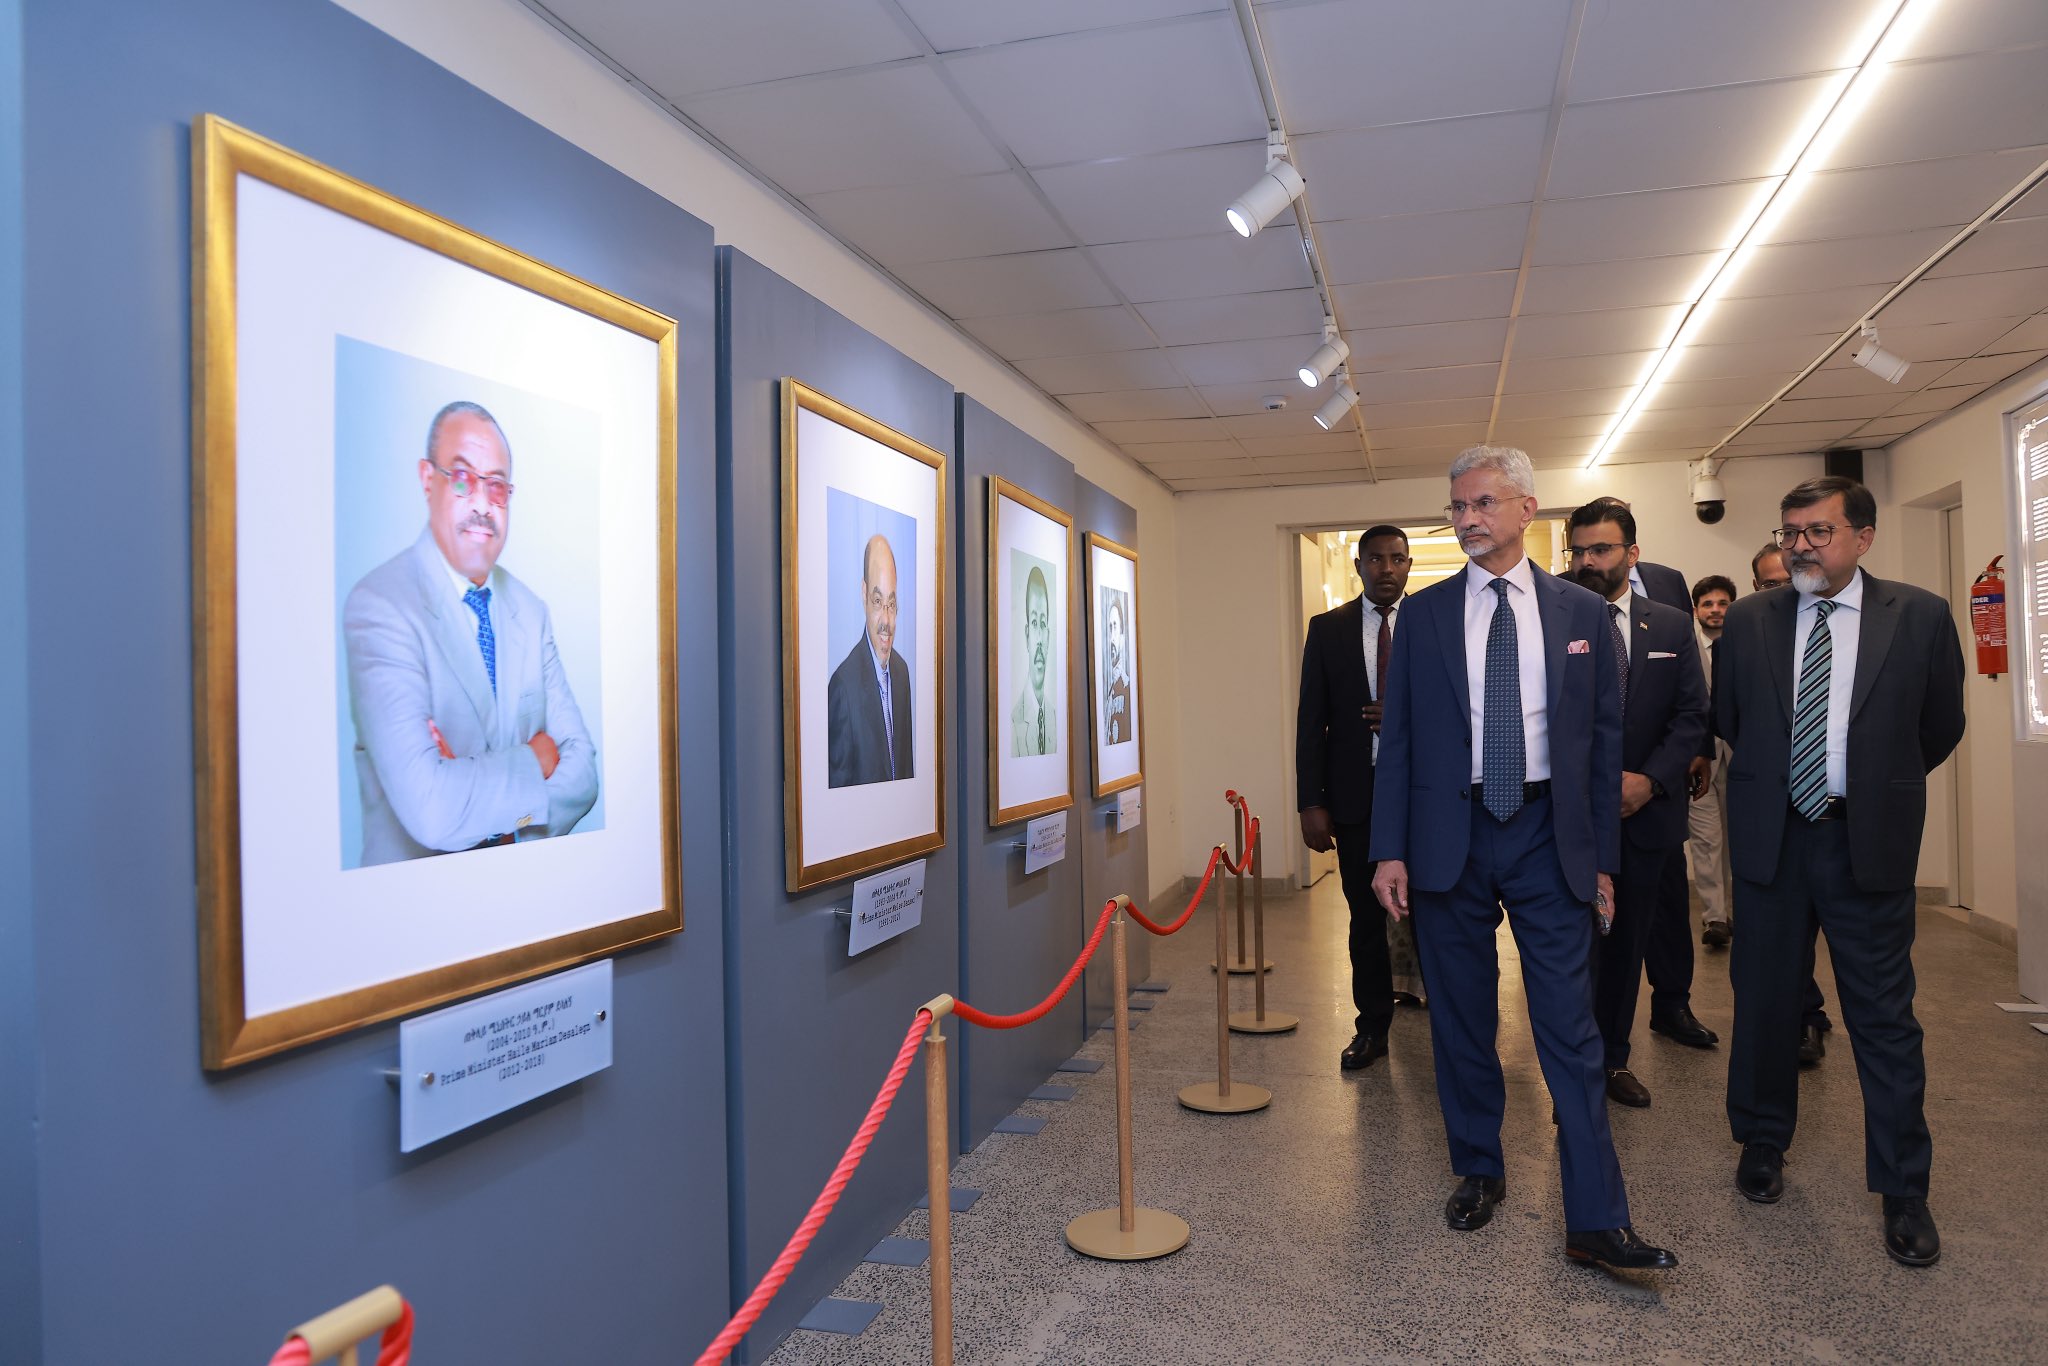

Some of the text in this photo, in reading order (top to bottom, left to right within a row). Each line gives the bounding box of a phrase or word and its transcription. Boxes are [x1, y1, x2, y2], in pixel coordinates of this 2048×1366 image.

[440, 1023, 592, 1086] Prime Minister Haile Mariam Desalegn
